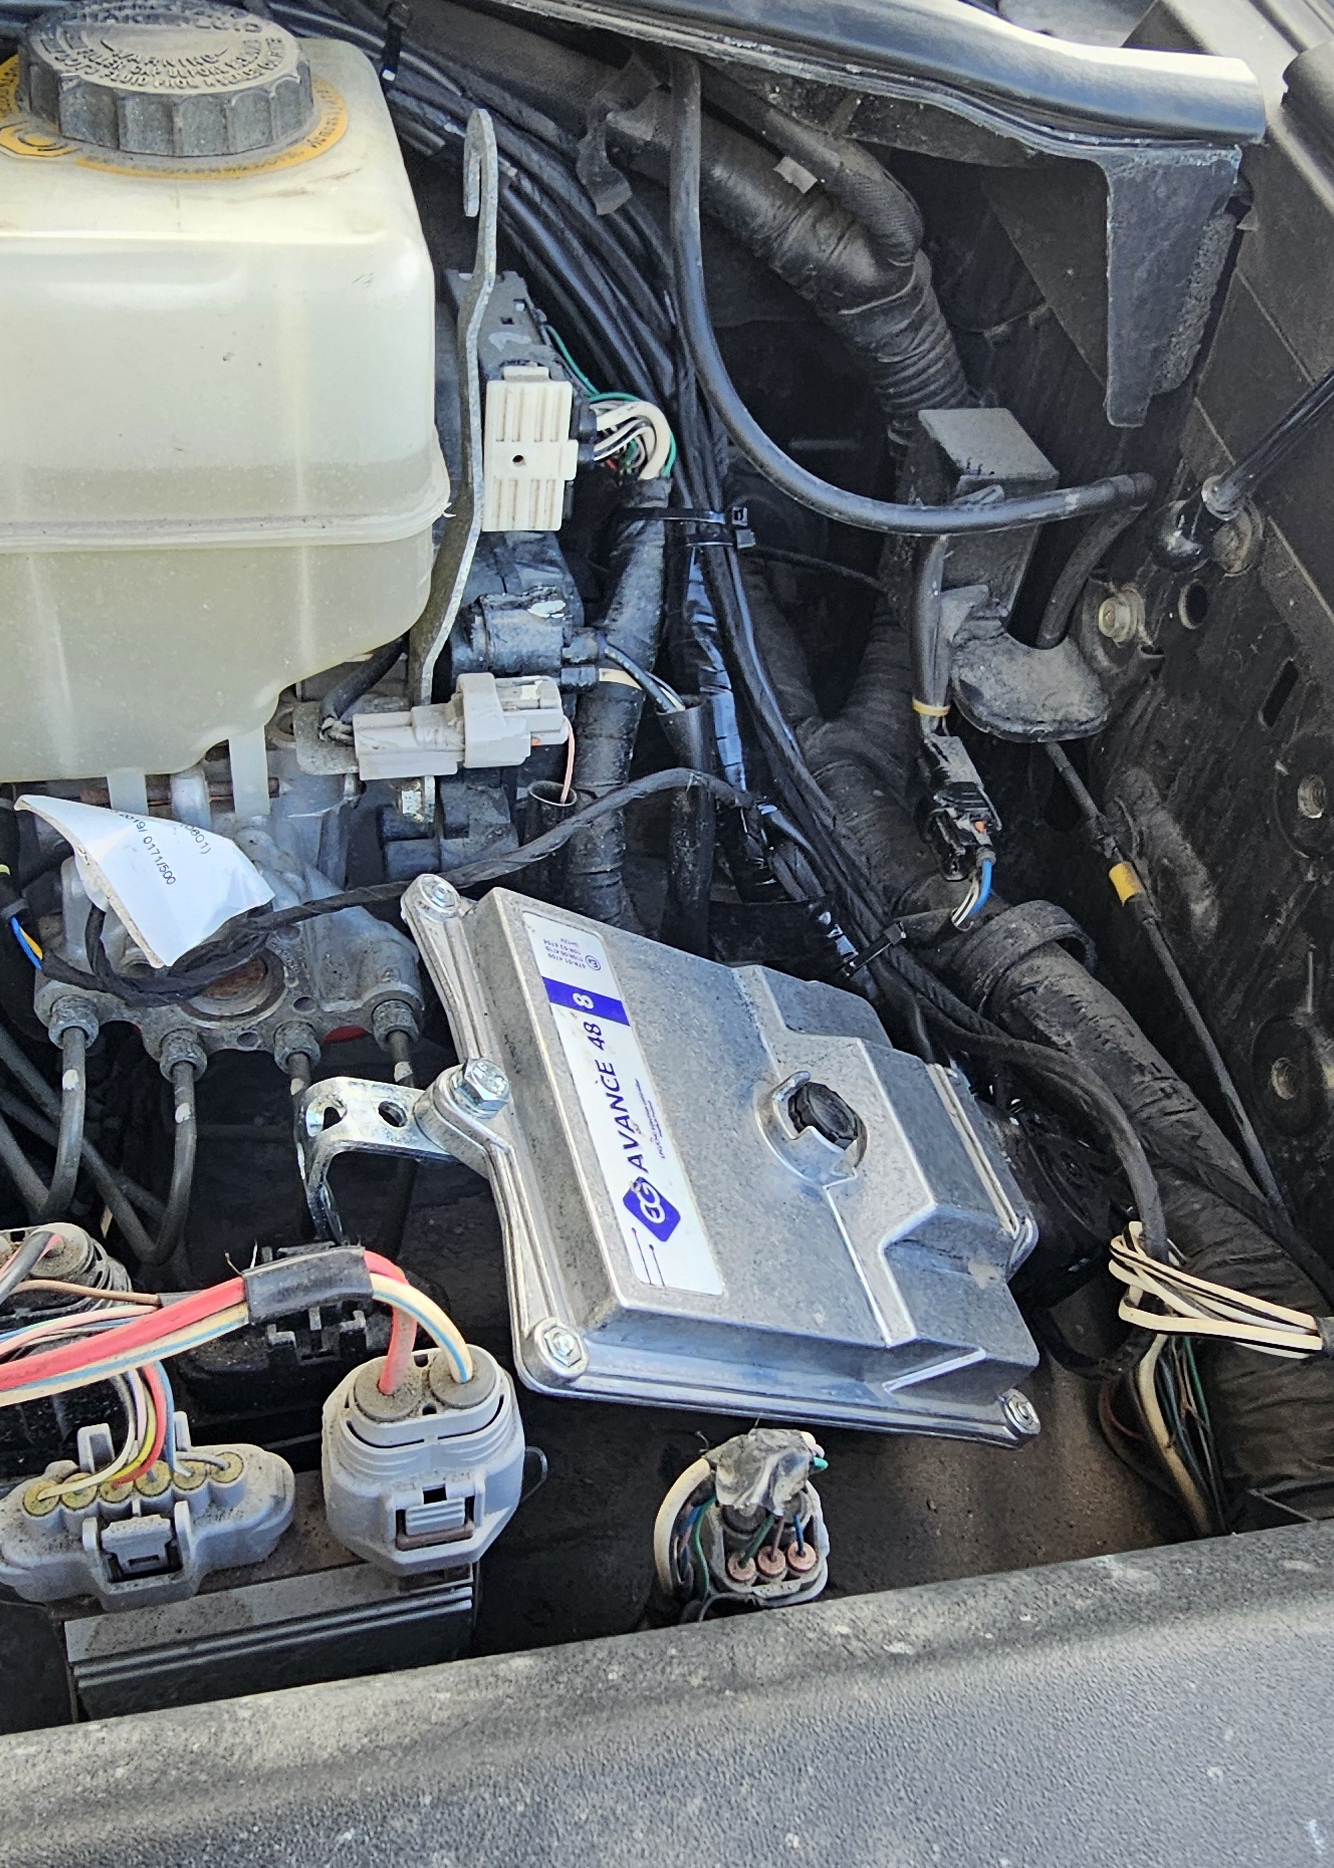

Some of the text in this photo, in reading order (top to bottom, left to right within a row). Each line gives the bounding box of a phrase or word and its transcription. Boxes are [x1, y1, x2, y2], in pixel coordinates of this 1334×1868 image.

[143, 836, 177, 885] 0171/500
[572, 992, 595, 1010] 8
[583, 1020, 607, 1051] 48
[594, 1059, 650, 1175] AVANCE
